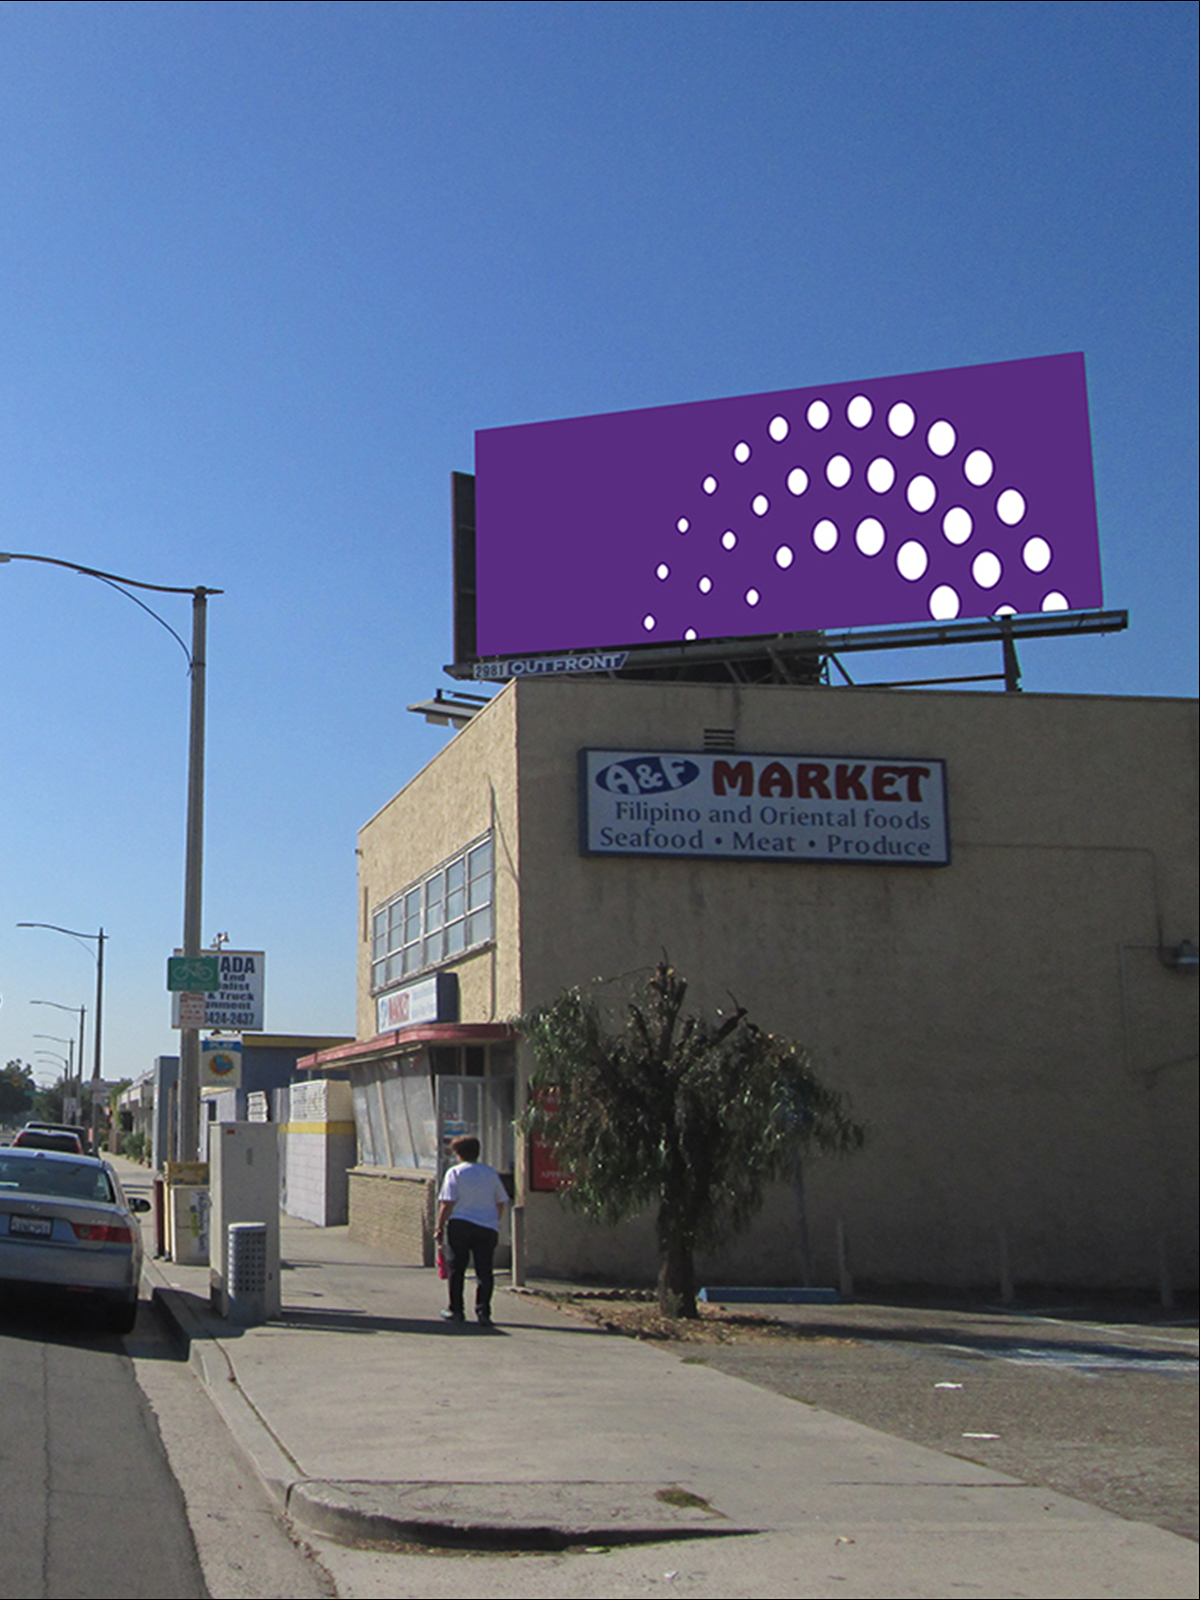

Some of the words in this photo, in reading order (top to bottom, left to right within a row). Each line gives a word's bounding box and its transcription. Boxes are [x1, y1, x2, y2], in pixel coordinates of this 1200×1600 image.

[475, 662, 504, 678] 2981
[511, 654, 621, 674] OUTFRONT
[606, 757, 686, 794] A&F
[712, 760, 931, 802] MARKET
[615, 801, 700, 826] Filipino
[709, 805, 752, 823] and
[760, 806, 856, 828] Oriental
[864, 809, 931, 830] foods
[600, 827, 703, 849] Seafood
[732, 832, 796, 852] Meat
[827, 834, 931, 856] Produce
[220, 992, 255, 1001] Truck
